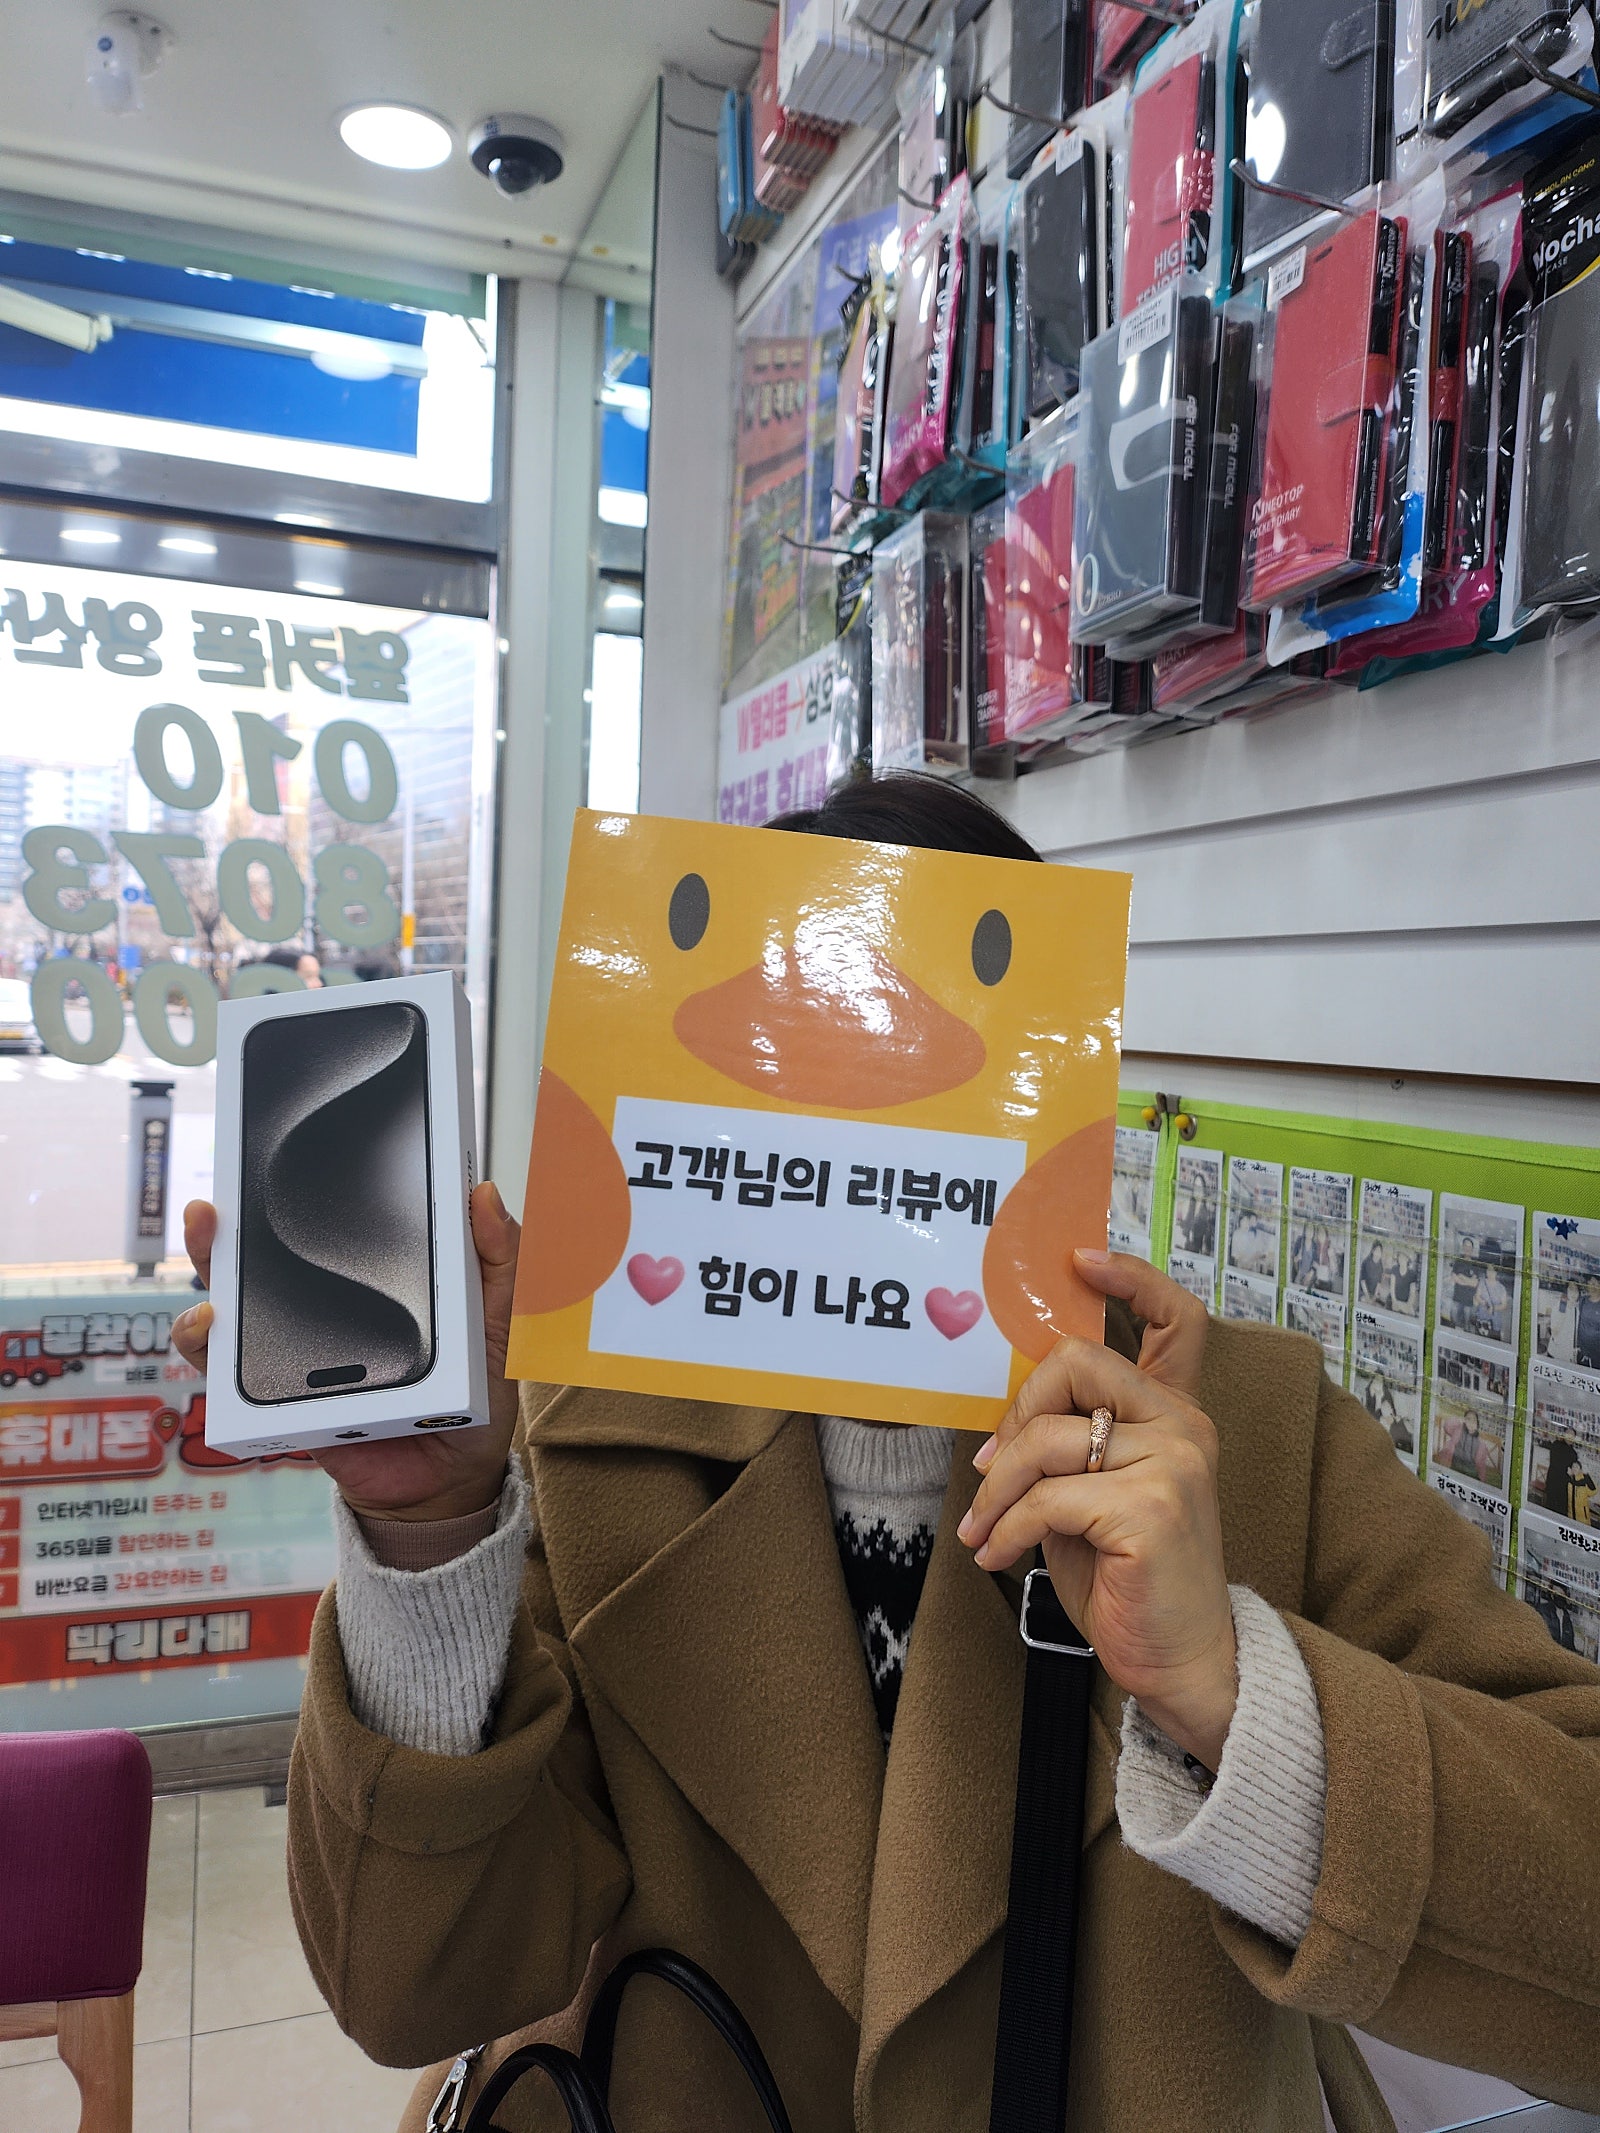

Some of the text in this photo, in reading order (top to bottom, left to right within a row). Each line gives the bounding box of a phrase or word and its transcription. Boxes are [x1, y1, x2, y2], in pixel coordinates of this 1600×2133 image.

[1153, 237, 1198, 280] HIGH
[1185, 394, 1198, 426] FOR
[1228, 422, 1240, 453] FOR
[1277, 505, 1301, 527] DIARY
[976, 689, 998, 708] SUPER
[628, 1141, 997, 1226] 고객님의 리뷰에
[699, 1255, 911, 1330] 힘이 나요
[0, 1410, 150, 1466] 휴대폰
[37, 1490, 228, 1521] 인터넷가입시 돈주는 집
[37, 1529, 215, 1560] 365일을 할인하는 집
[114, 1570, 204, 1592] 강요안하는
[210, 1565, 228, 1584] 집
[66, 1610, 250, 1664] 박리다매
